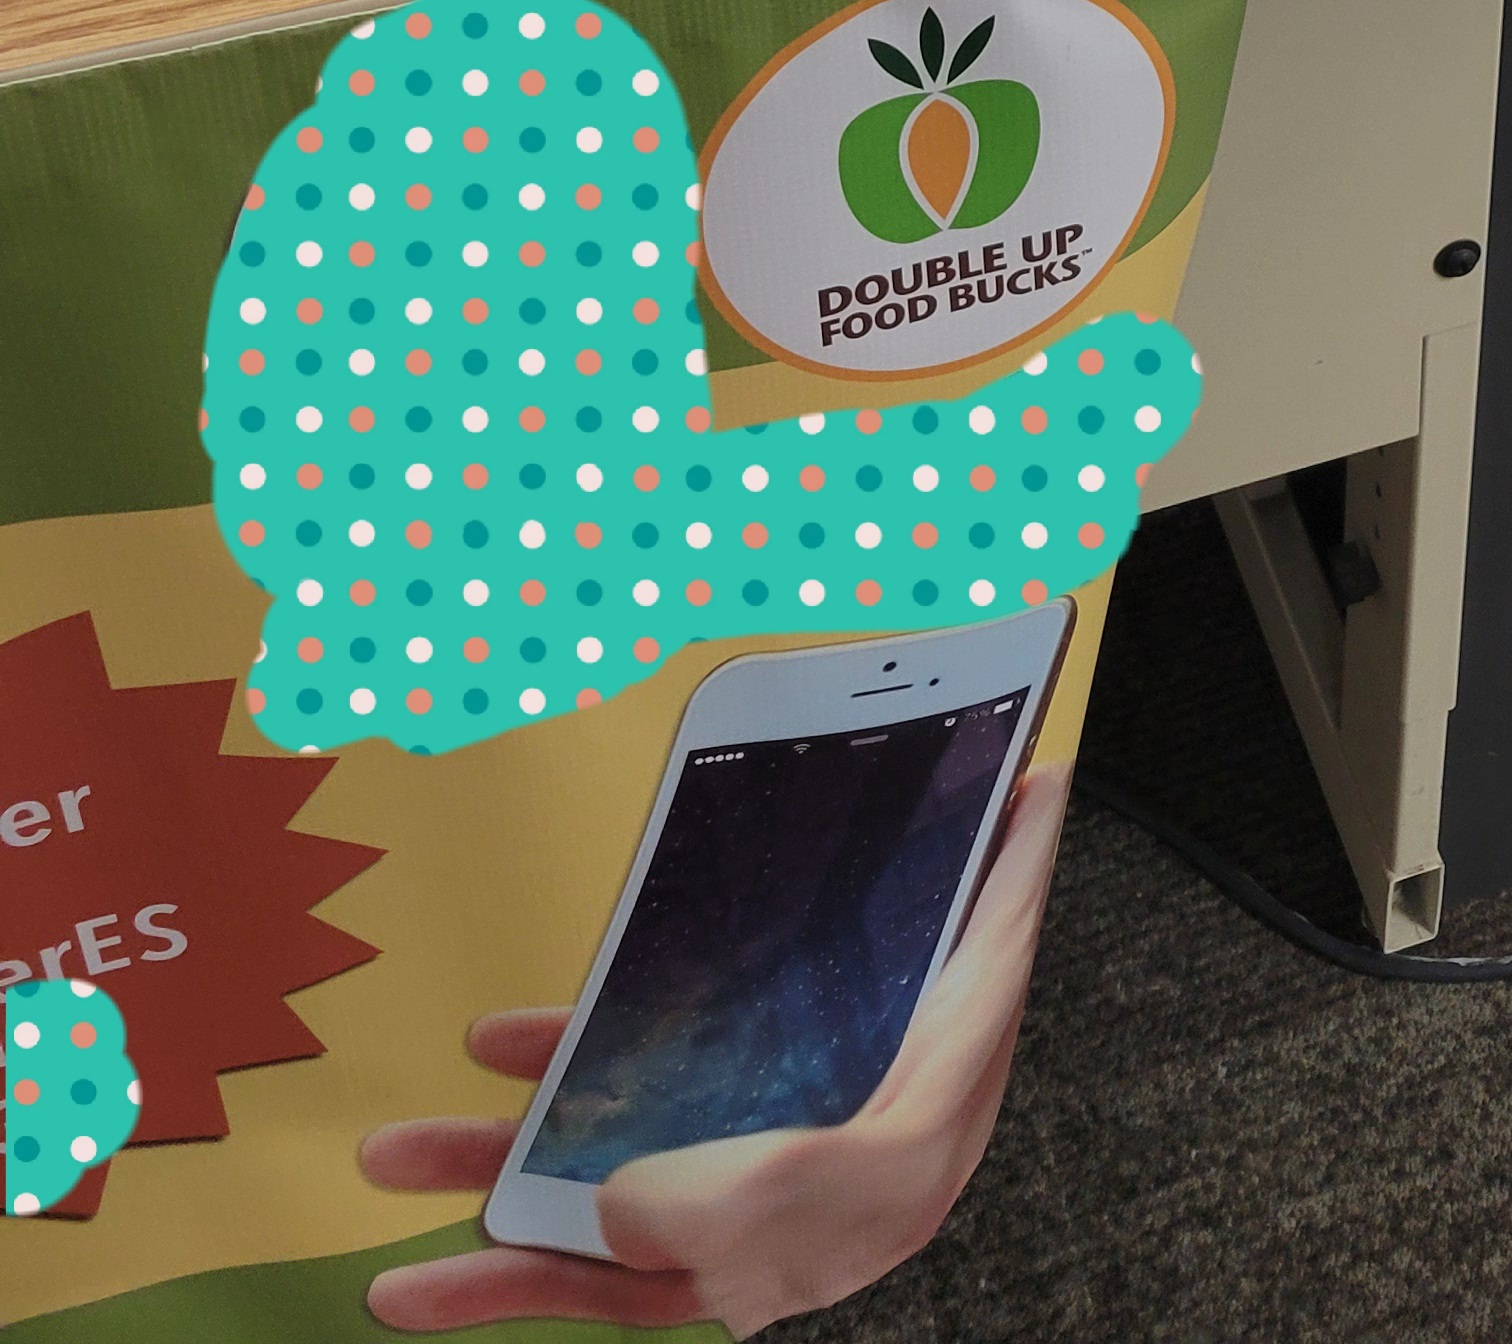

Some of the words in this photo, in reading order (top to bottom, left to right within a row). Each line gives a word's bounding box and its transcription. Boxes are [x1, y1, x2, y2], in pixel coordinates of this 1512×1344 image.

[817, 241, 1008, 319] DOUBLE
[1020, 223, 1085, 265] UP
[819, 291, 938, 348] FOOD
